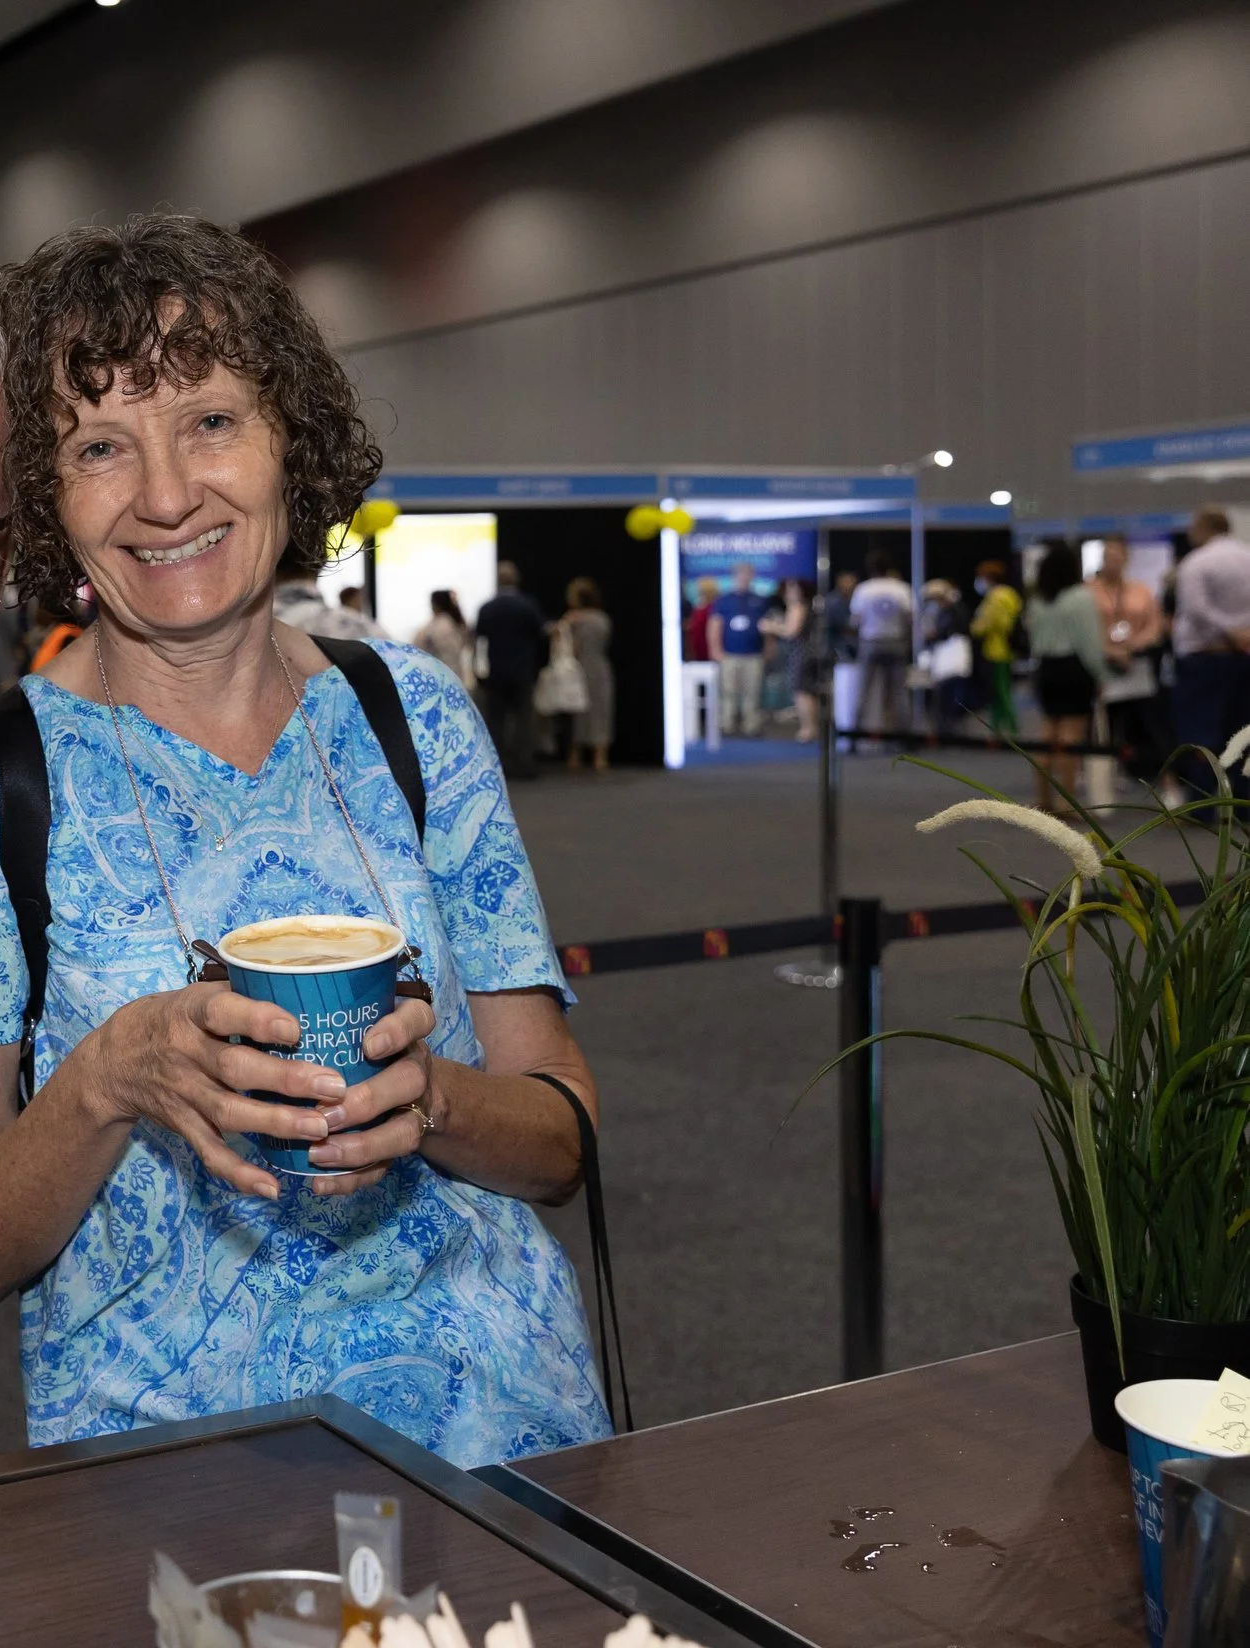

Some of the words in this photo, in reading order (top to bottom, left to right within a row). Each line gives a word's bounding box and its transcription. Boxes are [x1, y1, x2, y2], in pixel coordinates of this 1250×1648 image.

[299, 1013, 310, 1030] 5
[316, 1002, 379, 1029] HOURS
[333, 1047, 364, 1067] CU
